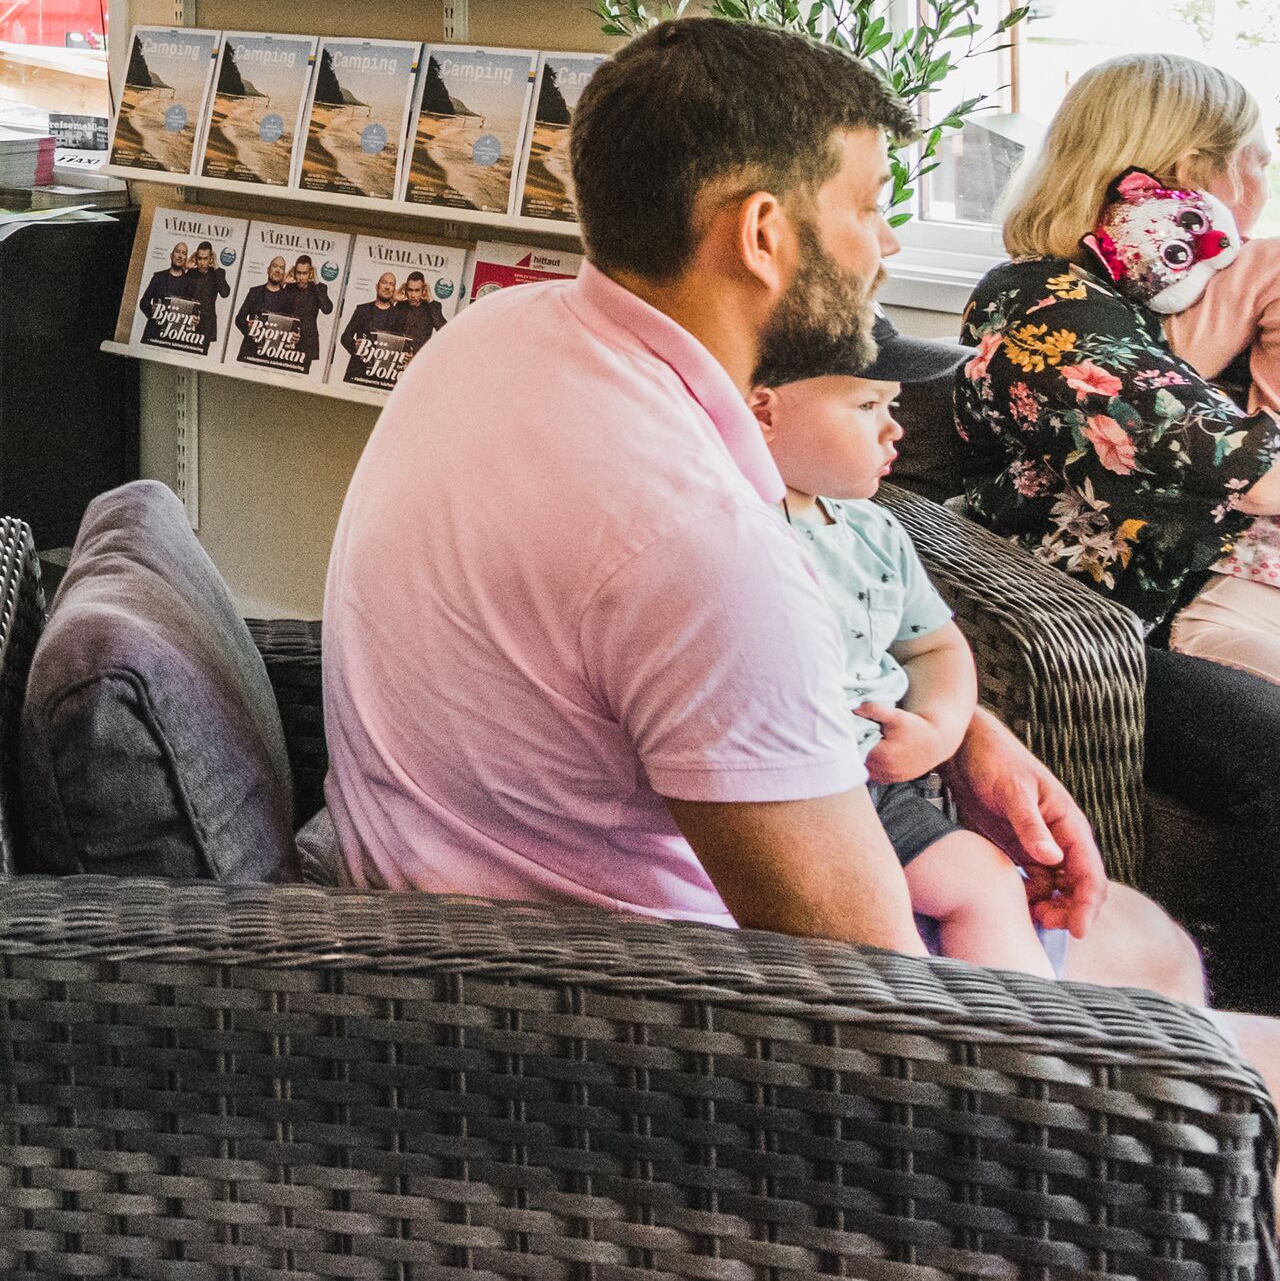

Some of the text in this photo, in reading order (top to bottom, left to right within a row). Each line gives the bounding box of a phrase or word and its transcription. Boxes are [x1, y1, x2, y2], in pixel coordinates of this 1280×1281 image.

[142, 38, 201, 60] Camping
[234, 44, 296, 68] Camping
[333, 52, 398, 75] Camping
[442, 59, 514, 85] Camping
[163, 216, 230, 239] VÄRMLAND
[259, 229, 332, 252] VÄRMLAND
[368, 244, 446, 268] VÄRMLAND
[152, 303, 193, 325] Björn
[159, 323, 205, 345] Johan
[248, 319, 293, 343] Björn
[257, 340, 306, 364] Johan
[355, 338, 406, 364] Björn
[365, 359, 399, 381] Joh
